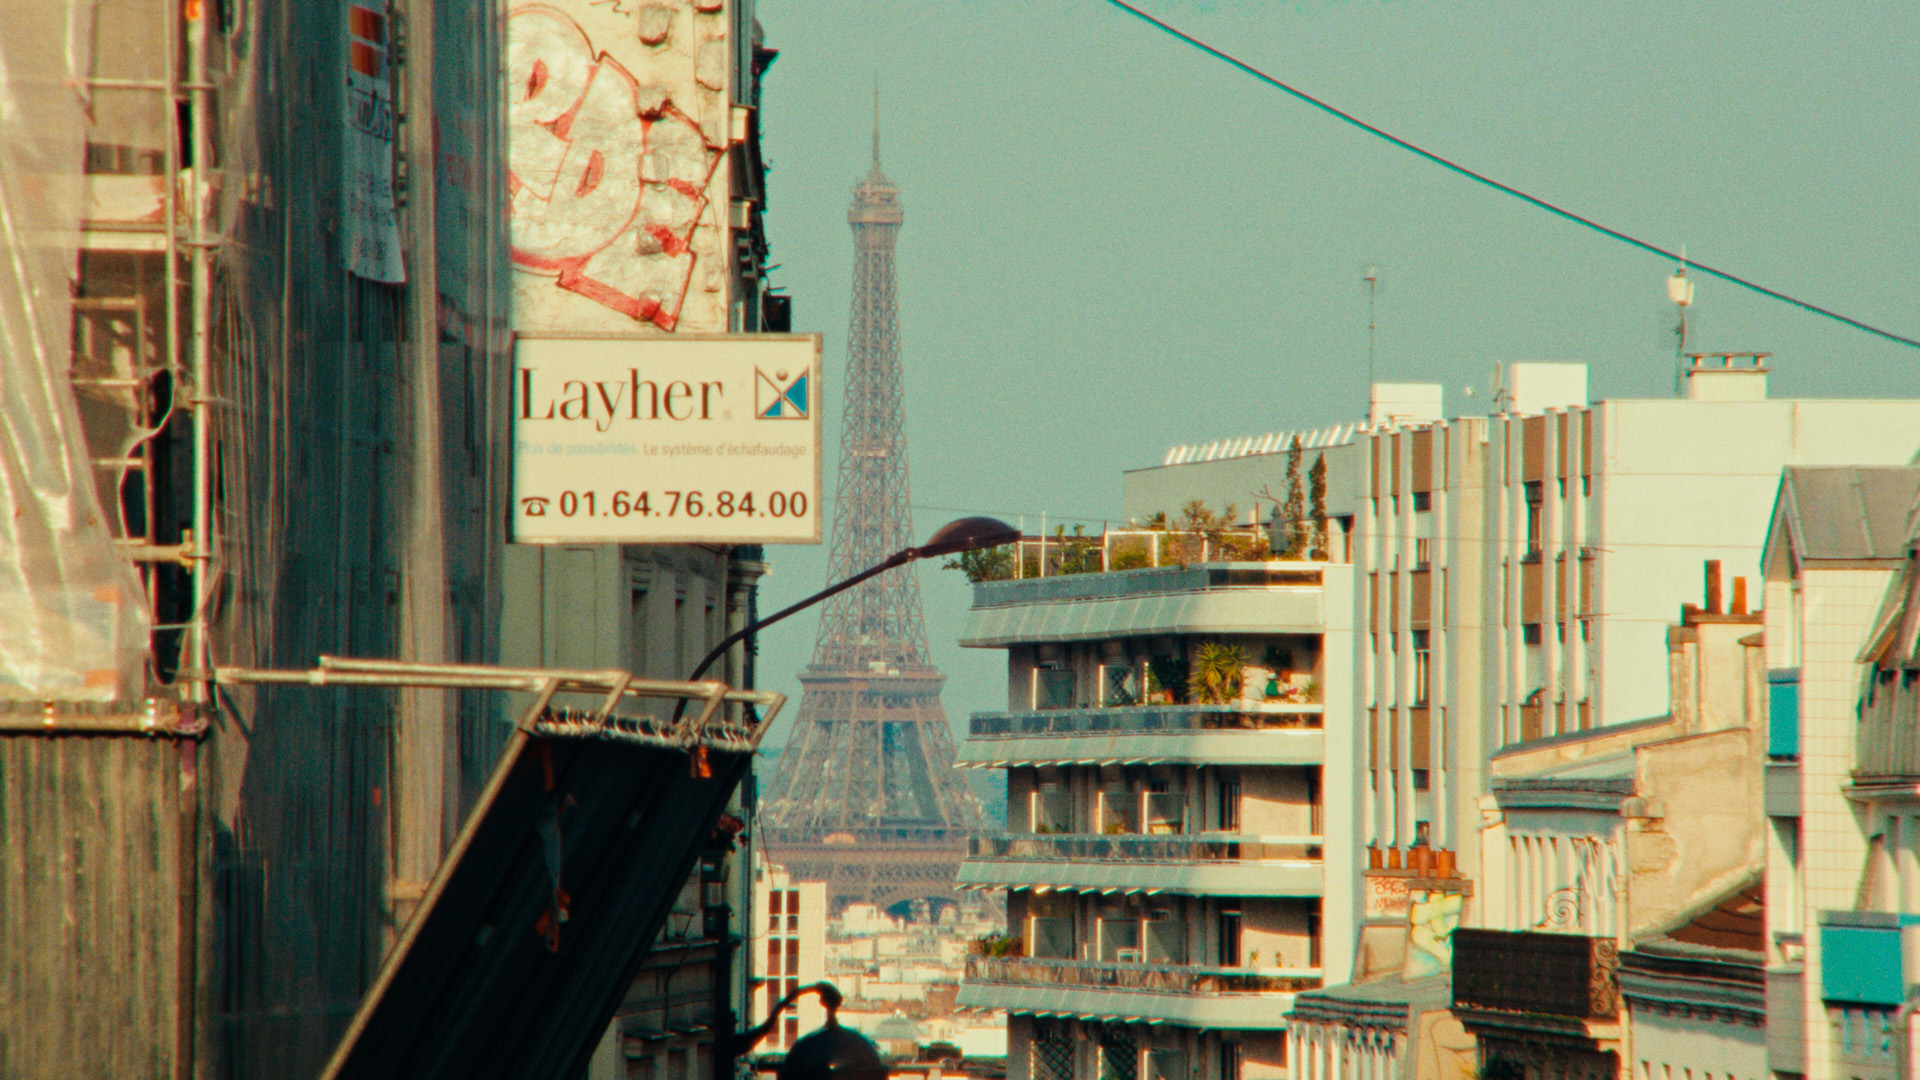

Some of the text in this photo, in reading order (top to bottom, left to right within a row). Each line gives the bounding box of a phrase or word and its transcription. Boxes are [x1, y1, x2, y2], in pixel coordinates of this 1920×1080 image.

[518, 367, 723, 432] Layher
[547, 441, 563, 455] de
[643, 443, 658, 456] Le
[662, 443, 712, 458] système
[559, 490, 808, 518] 01.64.76.84.00
